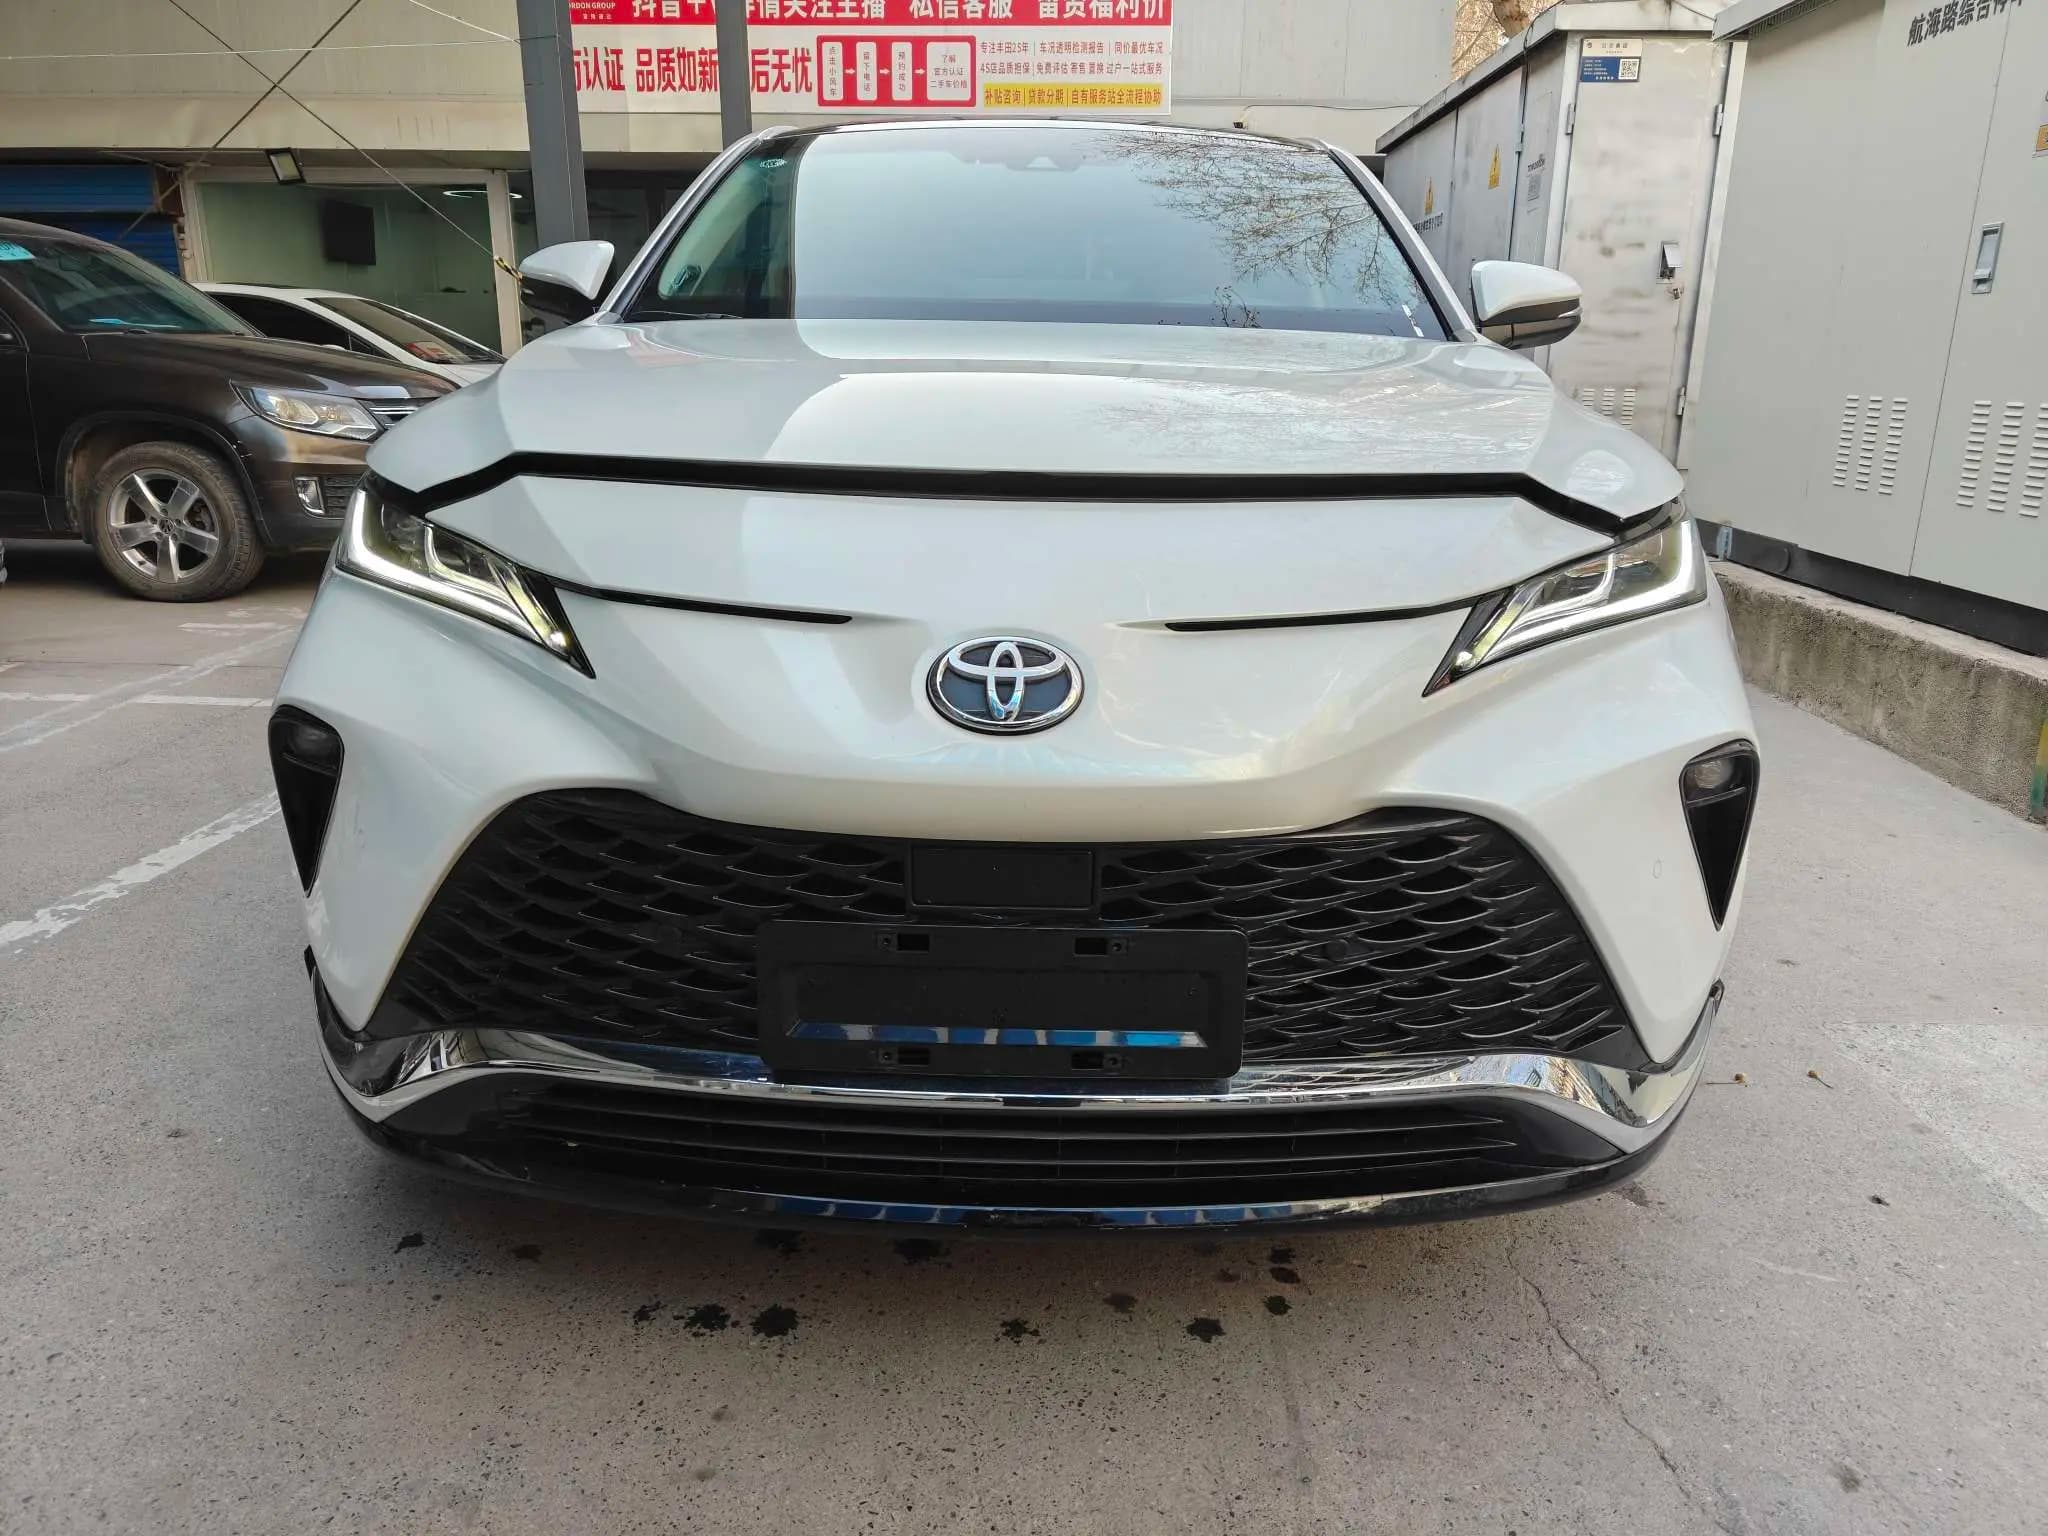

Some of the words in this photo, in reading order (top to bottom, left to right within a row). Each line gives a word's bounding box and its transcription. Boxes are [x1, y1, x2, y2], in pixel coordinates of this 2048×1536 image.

[980, 41, 1029, 54] 专注丰田25年
[1039, 41, 1105, 54] 车况透明检测报告
[1114, 41, 1164, 54] 同价最优车况
[942, 54, 957, 64] 了解
[636, 46, 719, 93] 品质如新
[750, 47, 813, 94] 后无忧
[863, 51, 872, 92] 留下电话
[898, 51, 906, 92] 预约成功
[933, 67, 964, 76] 官方认证
[980, 62, 1030, 75] 4S店品质担保
[930, 80, 968, 89] 二手车价格
[984, 87, 1021, 105] 补贴咨询
[1028, 87, 1064, 105] 贷款分期
[1071, 87, 1161, 105] 自有服务站全流程协助
